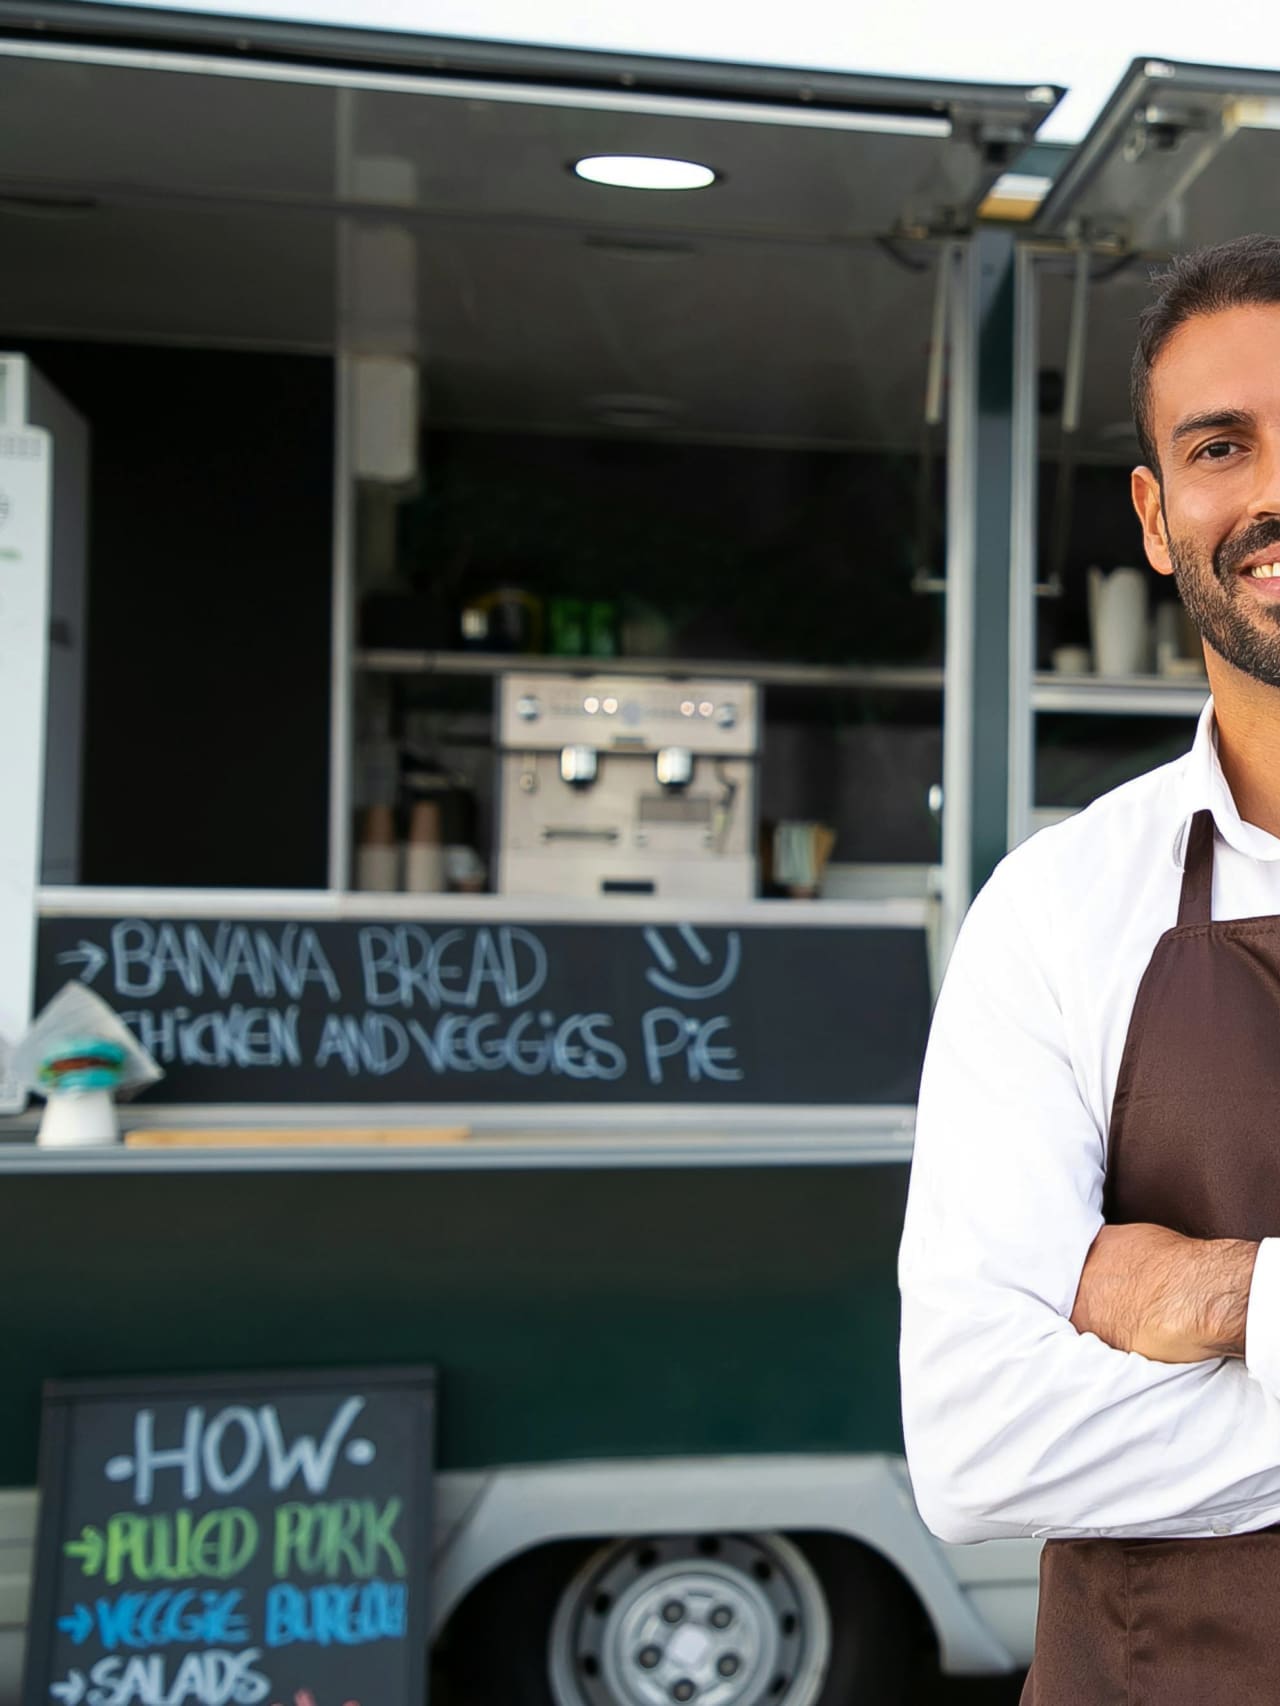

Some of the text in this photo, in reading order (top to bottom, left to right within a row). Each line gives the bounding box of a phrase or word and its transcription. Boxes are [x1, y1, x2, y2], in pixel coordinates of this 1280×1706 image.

[111, 918, 548, 1009] BANANA BREAD
[120, 1004, 301, 1068] HiCKEN
[314, 1010, 410, 1076] AND
[134, 1395, 366, 1504] HOW
[272, 1499, 406, 1579] PORK
[88, 1648, 271, 1706] SALADS
